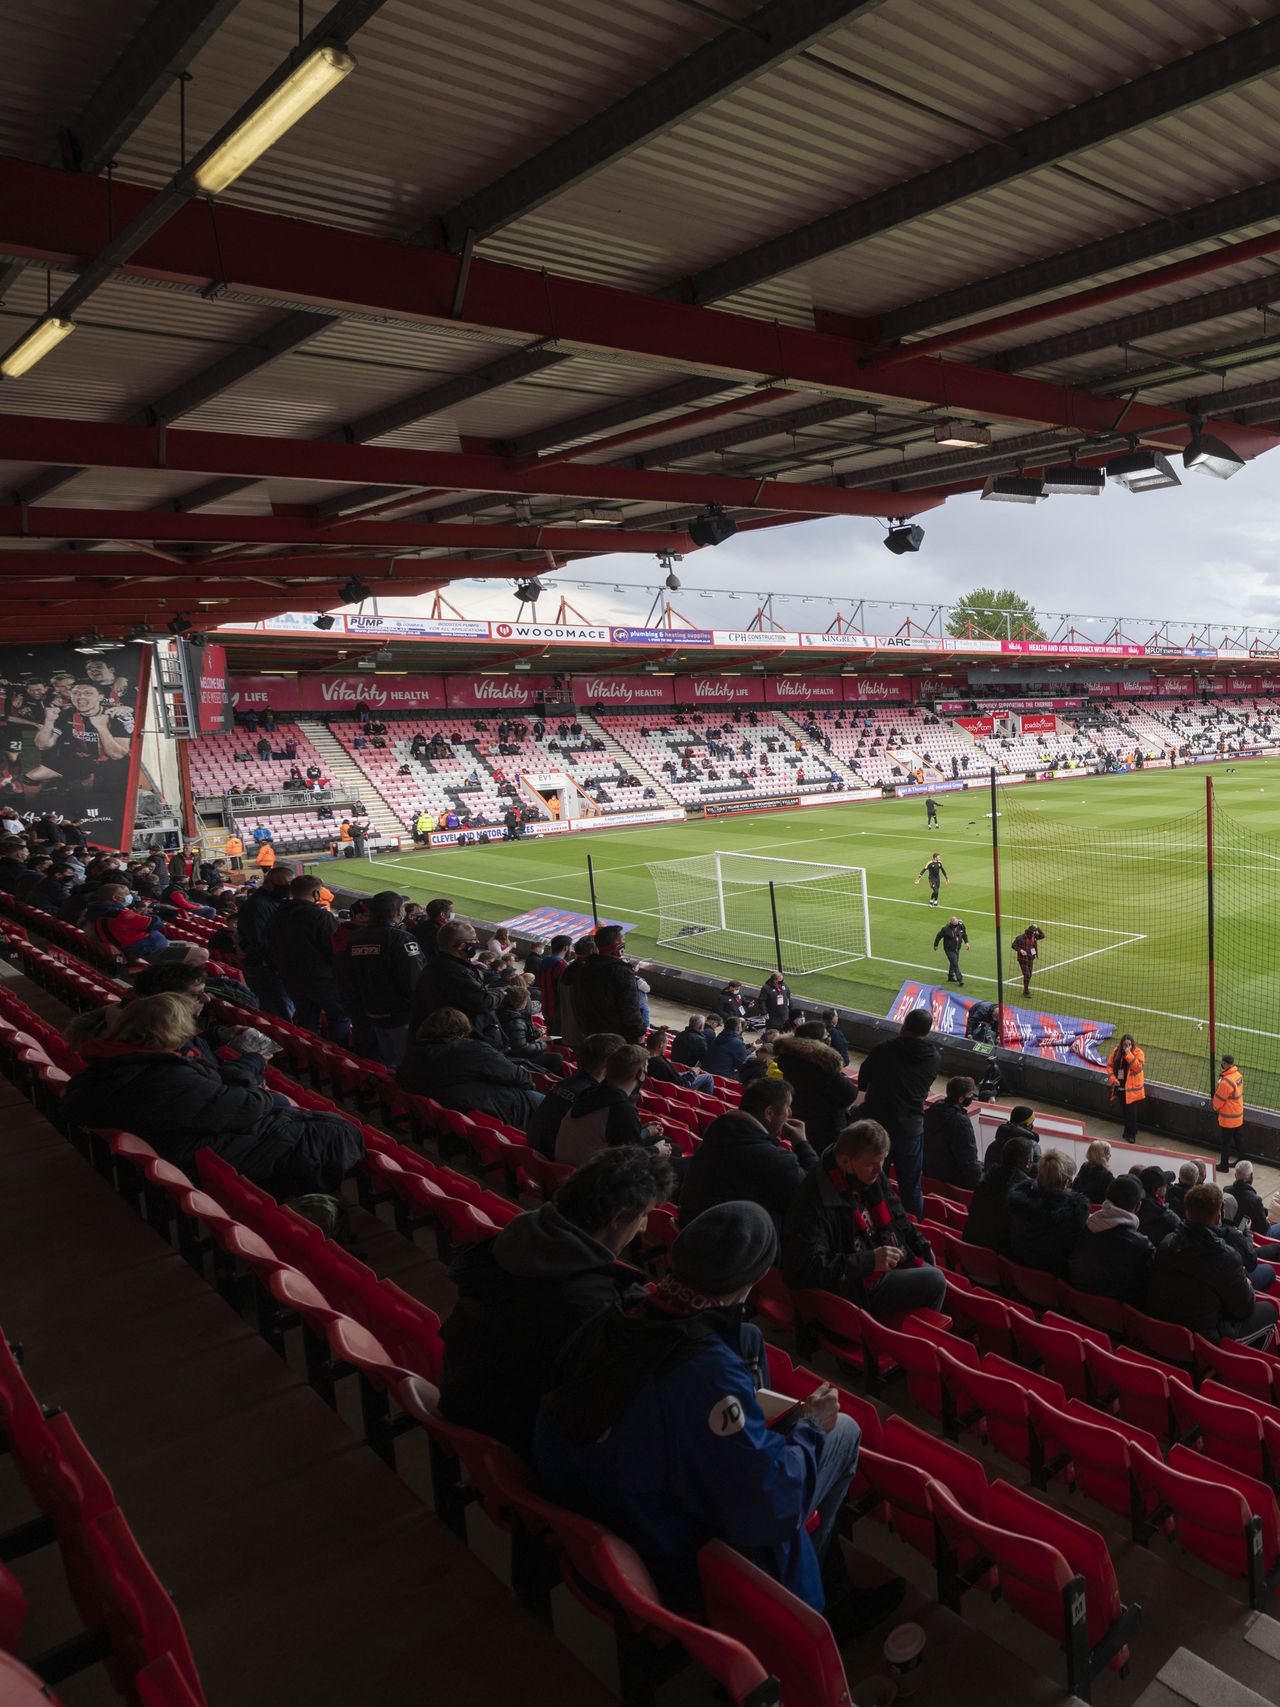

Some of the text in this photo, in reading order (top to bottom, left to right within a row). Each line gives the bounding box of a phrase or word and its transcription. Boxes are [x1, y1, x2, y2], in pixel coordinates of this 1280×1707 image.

[351, 617, 384, 628] PUMP
[516, 627, 606, 639] WOODMACE
[630, 631, 658, 639] plumbing
[664, 631, 686, 639] heating
[729, 633, 747, 642] CPH
[887, 638, 911, 647] ARC
[1028, 643, 1047, 651] HEALTH
[1059, 644, 1068, 652] LIFE
[1069, 644, 1094, 652] INSURANCE
[1094, 645, 1106, 653] WITH
[1106, 646, 1123, 654] VITALITY
[321, 680, 429, 707] Vitality HEALTH
[474, 679, 528, 705] Vitality
[586, 679, 633, 702] Vitality
[694, 680, 749, 701] Vitality LIFE
[776, 680, 834, 700] Vitality HEALTH
[858, 680, 890, 699] Vitality
[245, 692, 268, 702] LIFE
[1024, 720, 1054, 731] goadsby.com
[721, 1401, 741, 1431] JD
